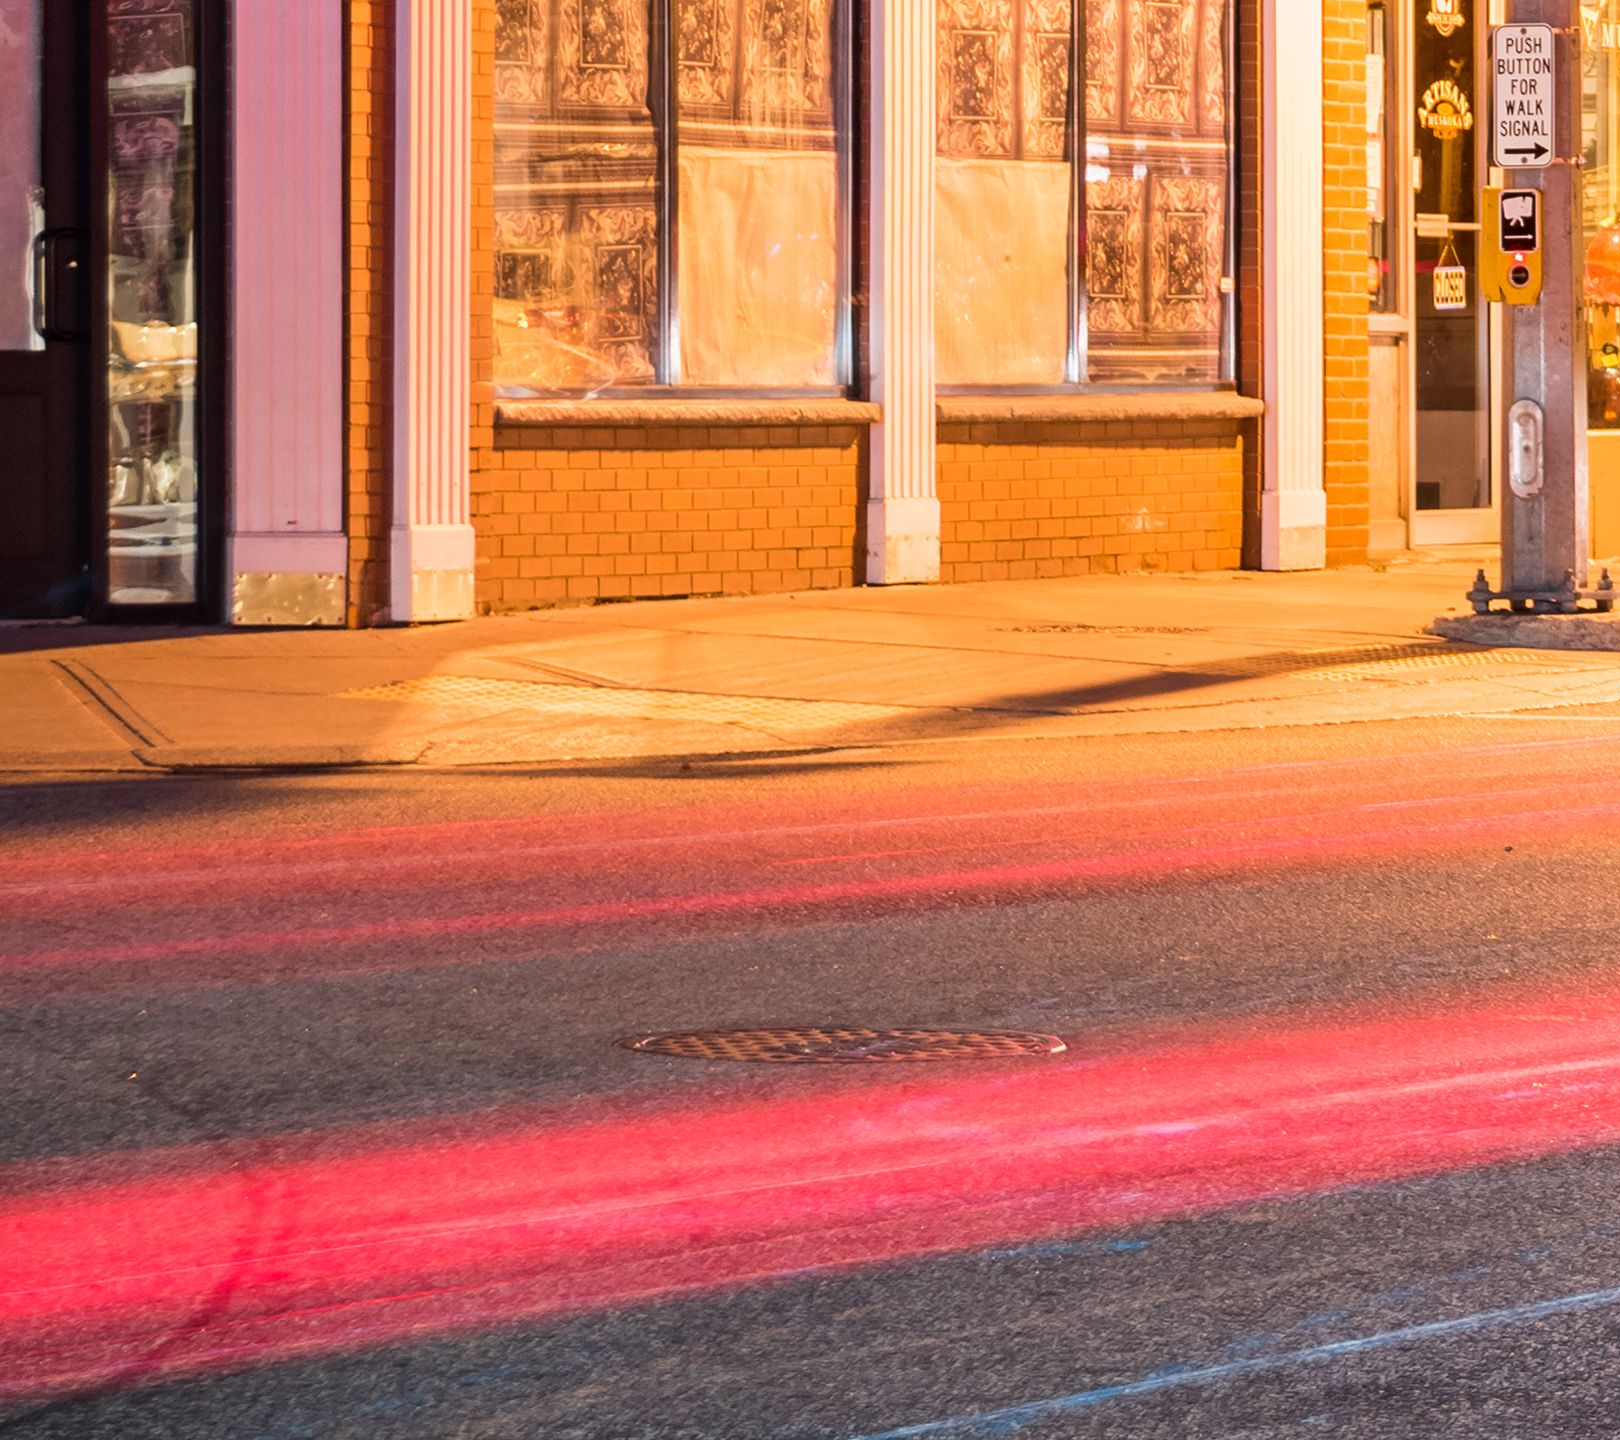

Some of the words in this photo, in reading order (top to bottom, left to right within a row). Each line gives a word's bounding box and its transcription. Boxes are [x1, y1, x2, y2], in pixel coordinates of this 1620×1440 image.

[1505, 37, 1542, 54] PUSH
[1498, 58, 1551, 75] BUTTON
[1510, 79, 1538, 95] FOR
[1505, 99, 1543, 116] WALK
[1500, 120, 1549, 137] SIGNAL
